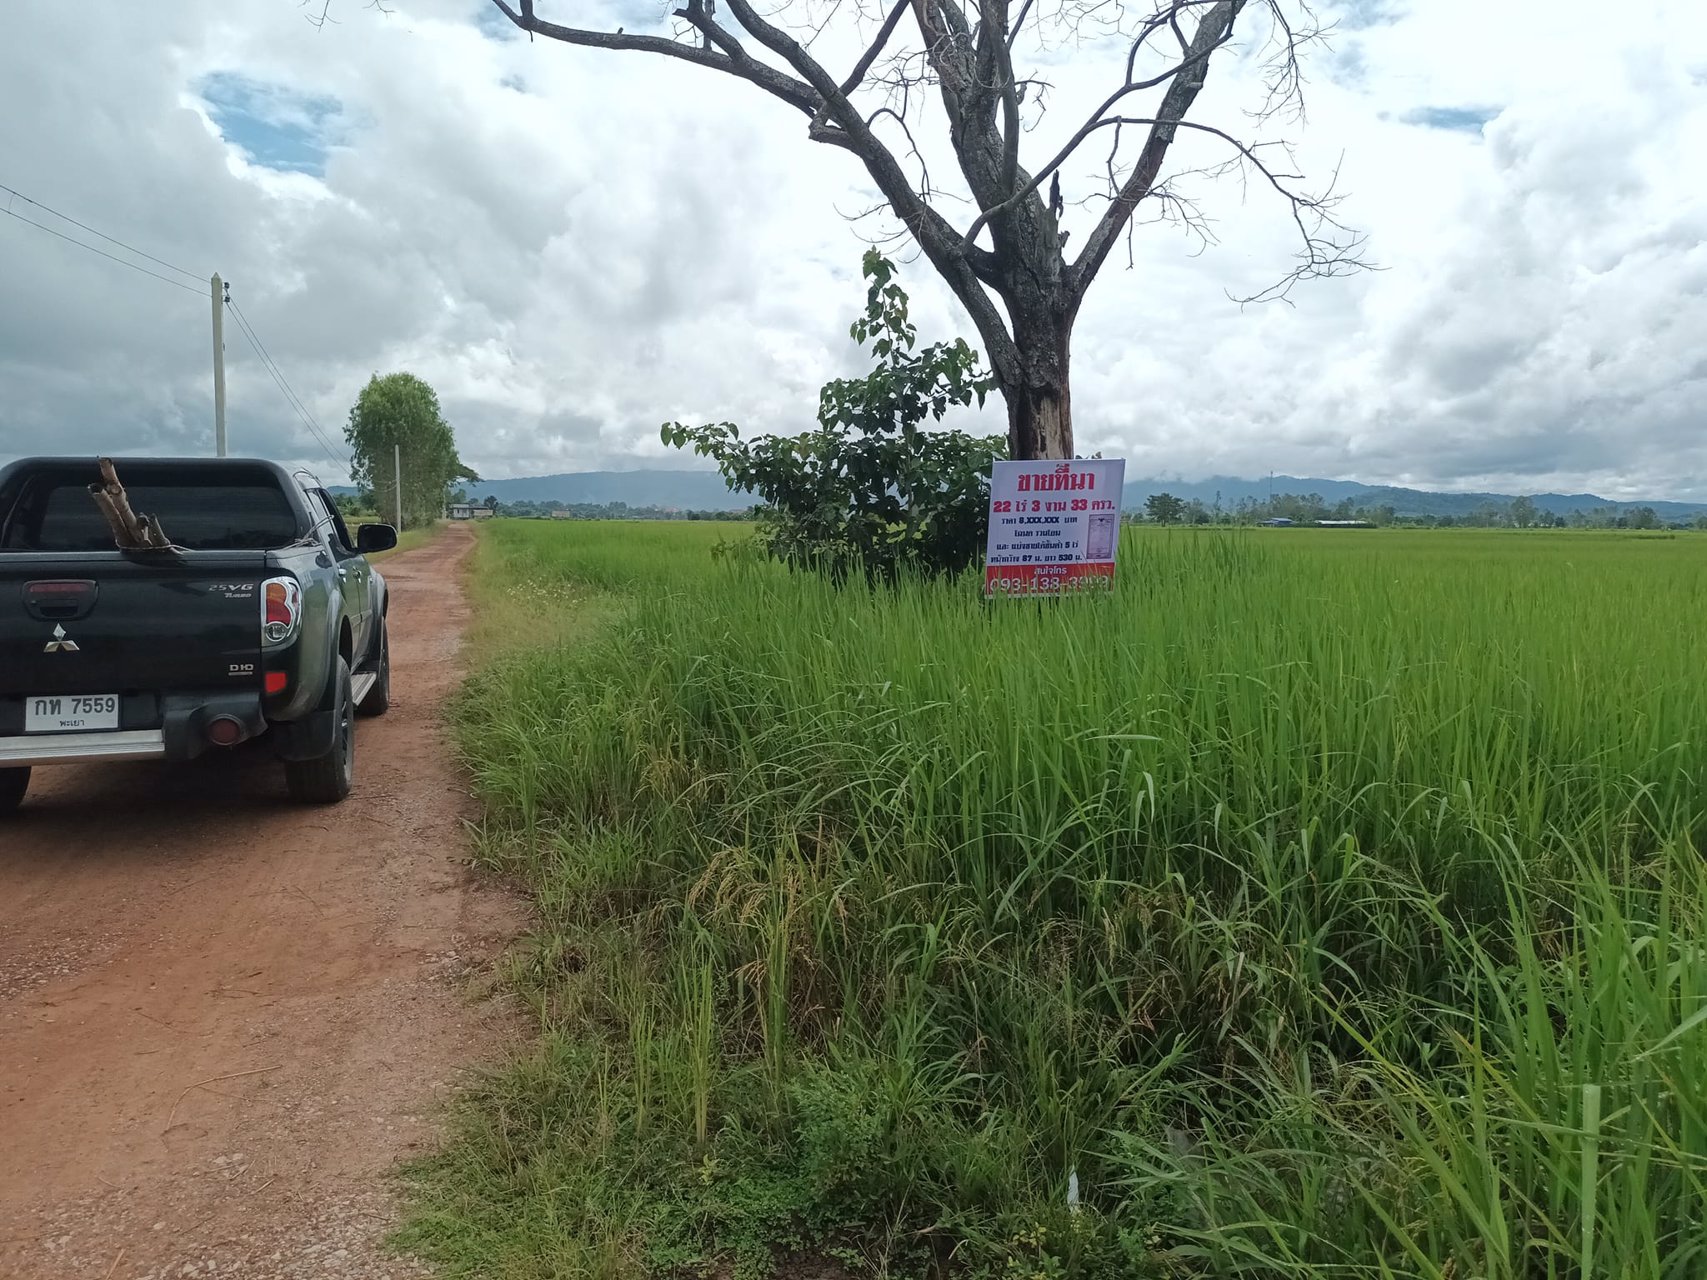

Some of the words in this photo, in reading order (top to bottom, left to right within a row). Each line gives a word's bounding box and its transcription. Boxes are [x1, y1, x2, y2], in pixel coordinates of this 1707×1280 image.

[1017, 464, 1095, 491] ขายที่นา
[993, 500, 1012, 513] 22
[1015, 500, 1027, 512] ไร่
[1031, 500, 1041, 512] 3
[1045, 501, 1067, 512] งาน
[1071, 499, 1088, 511] 33
[1065, 541, 1070, 549] 5
[1058, 553, 1073, 561] 530
[35, 699, 62, 716] กท
[71, 697, 116, 714] 7559
[59, 719, 85, 727] พะเยา
